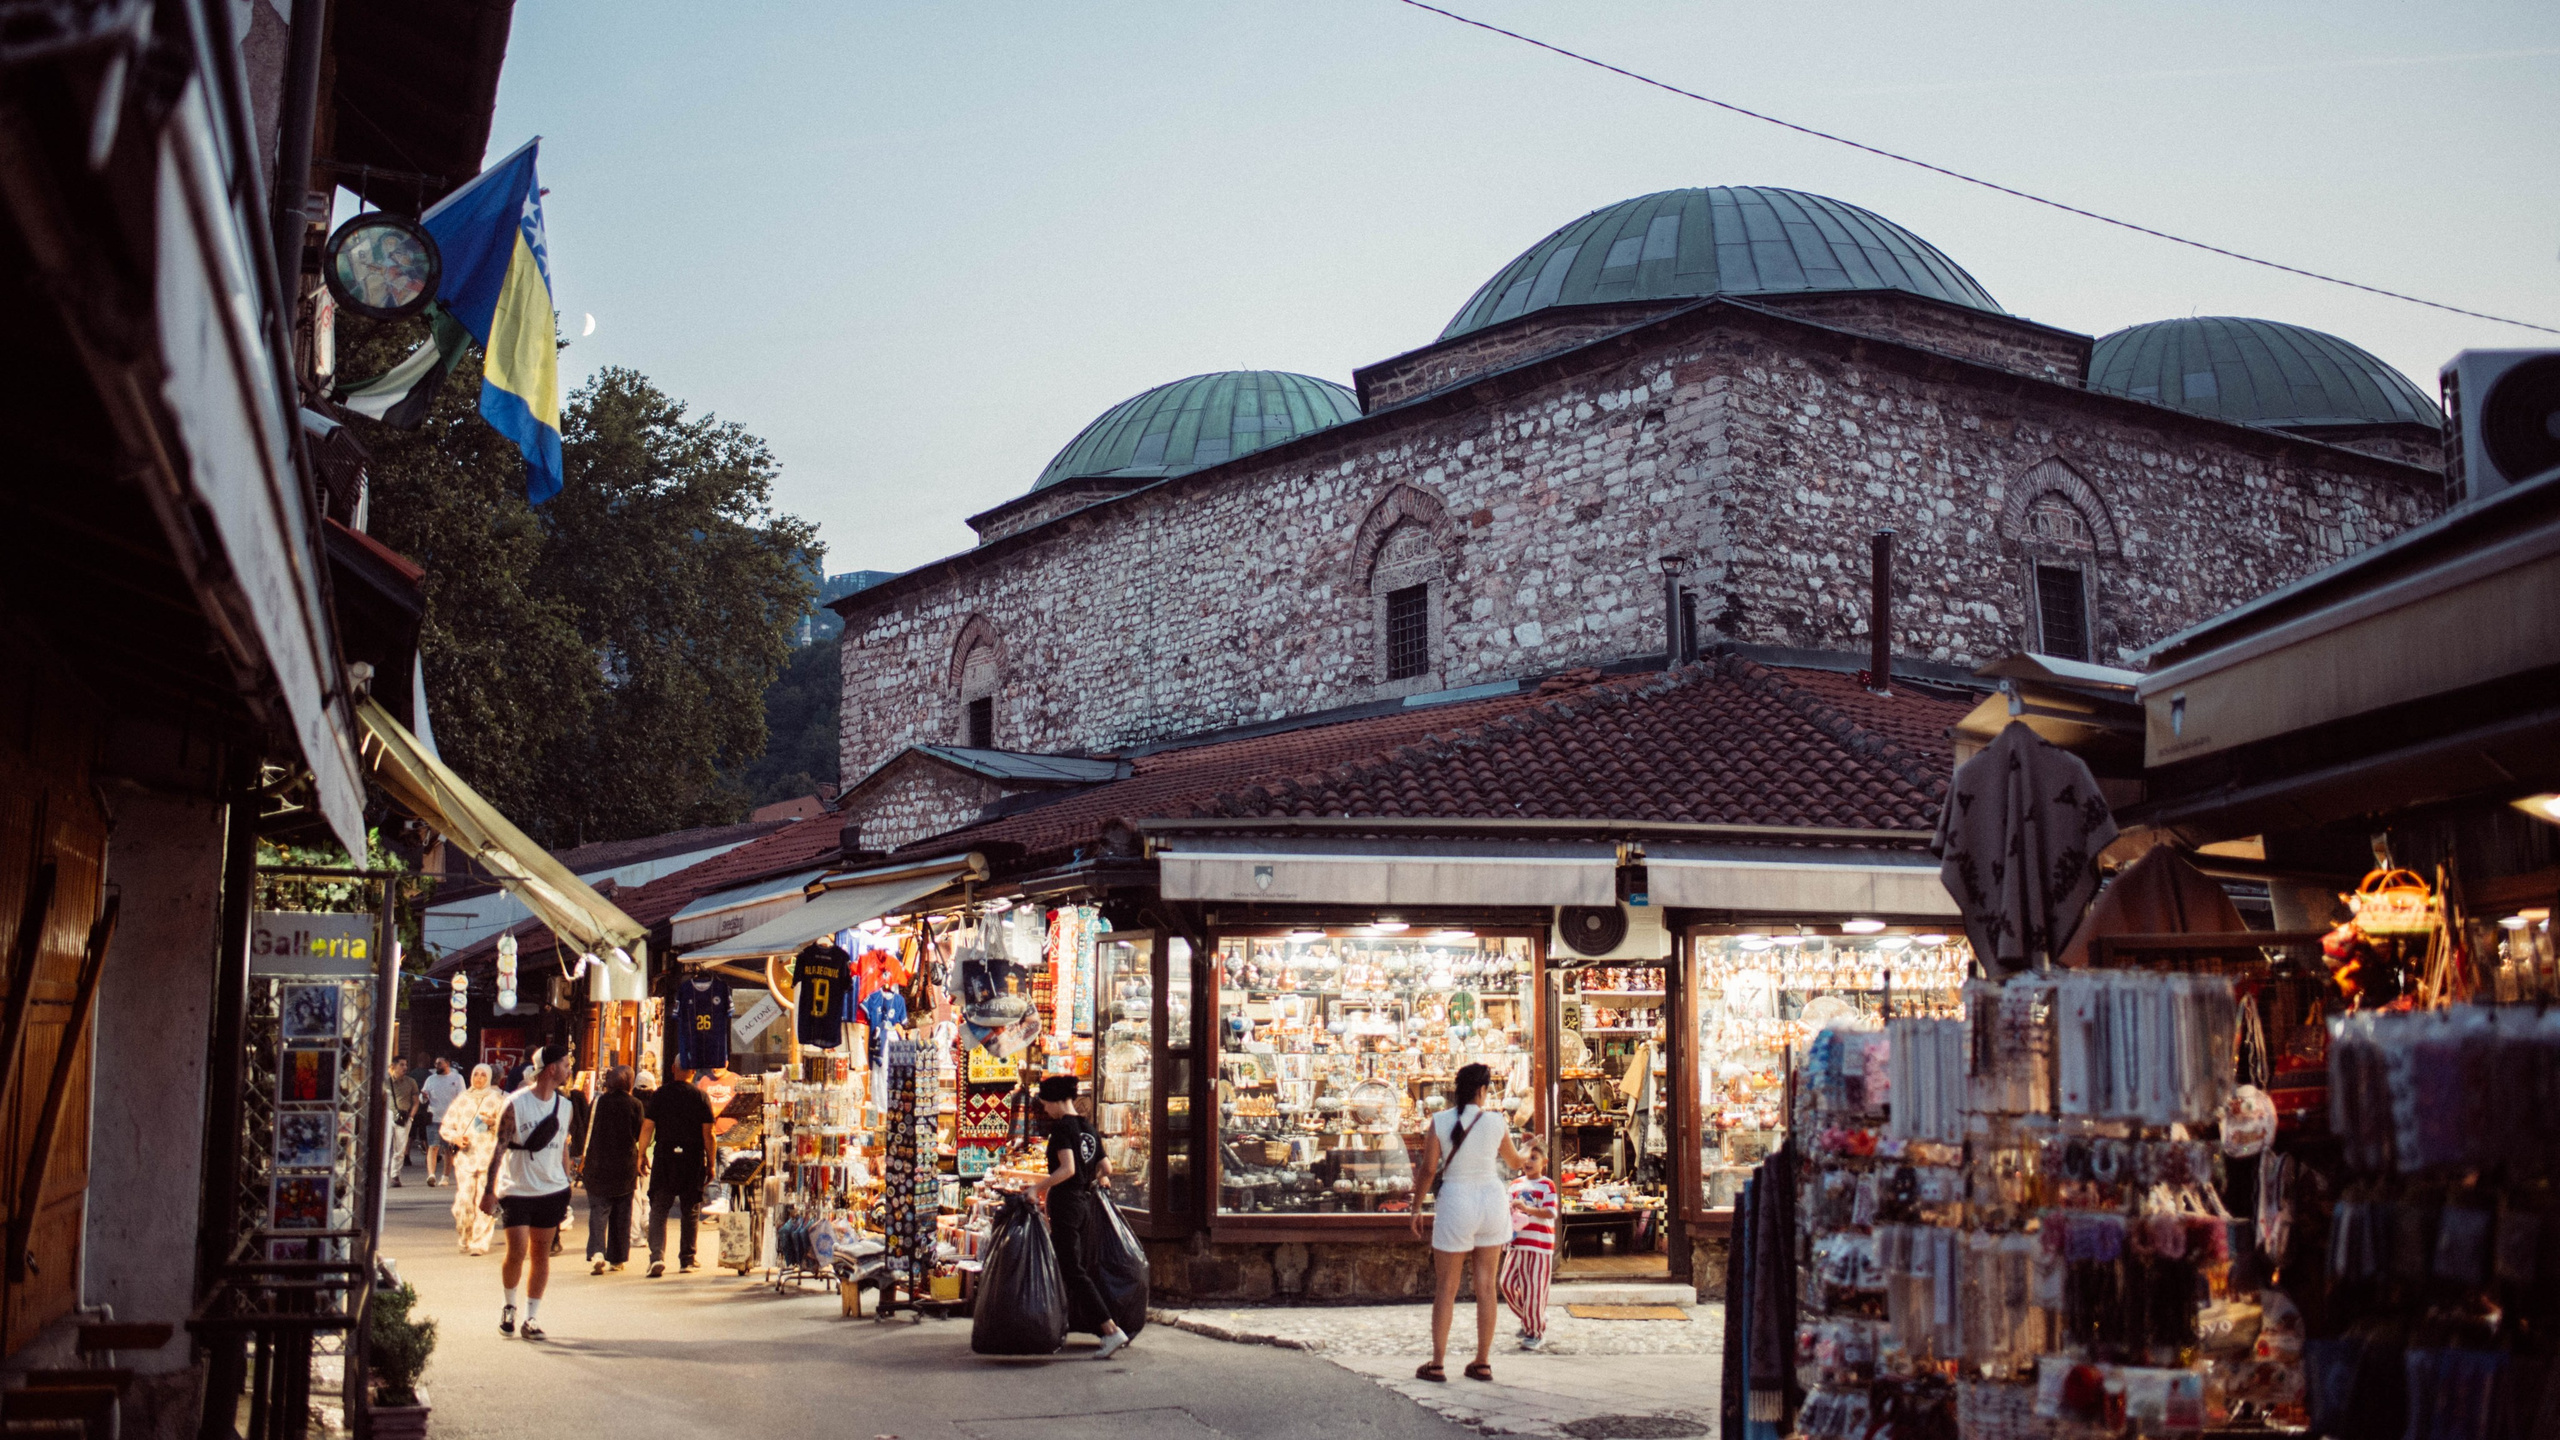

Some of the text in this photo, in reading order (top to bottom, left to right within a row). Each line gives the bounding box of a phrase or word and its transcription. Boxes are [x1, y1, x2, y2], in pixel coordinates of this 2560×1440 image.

[252, 929, 367, 959] Galleria
[811, 978, 830, 1018] 19
[974, 1002, 1018, 1012] Sarajevo
[696, 1014, 712, 1031] 26
